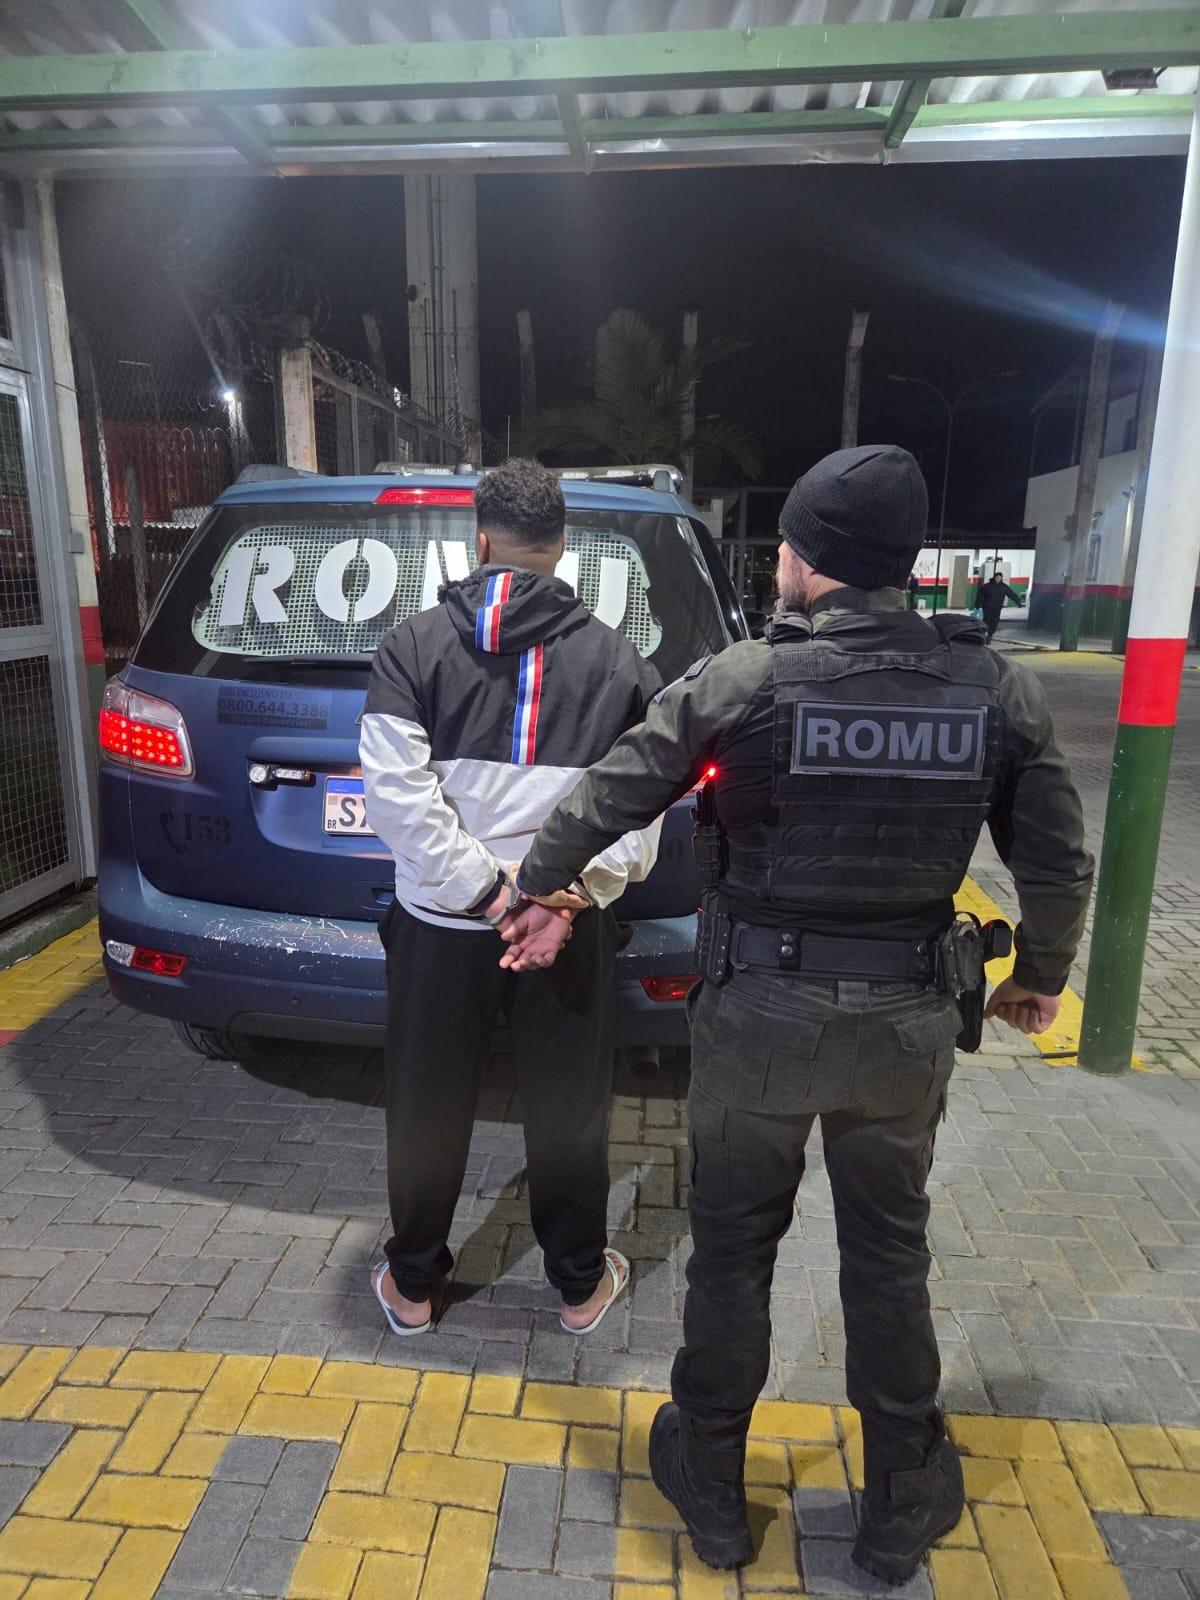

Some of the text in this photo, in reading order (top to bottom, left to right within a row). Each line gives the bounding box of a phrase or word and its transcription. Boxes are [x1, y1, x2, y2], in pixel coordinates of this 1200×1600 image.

[218, 698, 329, 717] 0800.644.3388
[806, 717, 973, 763] ROMU
[327, 819, 337, 829] BR
